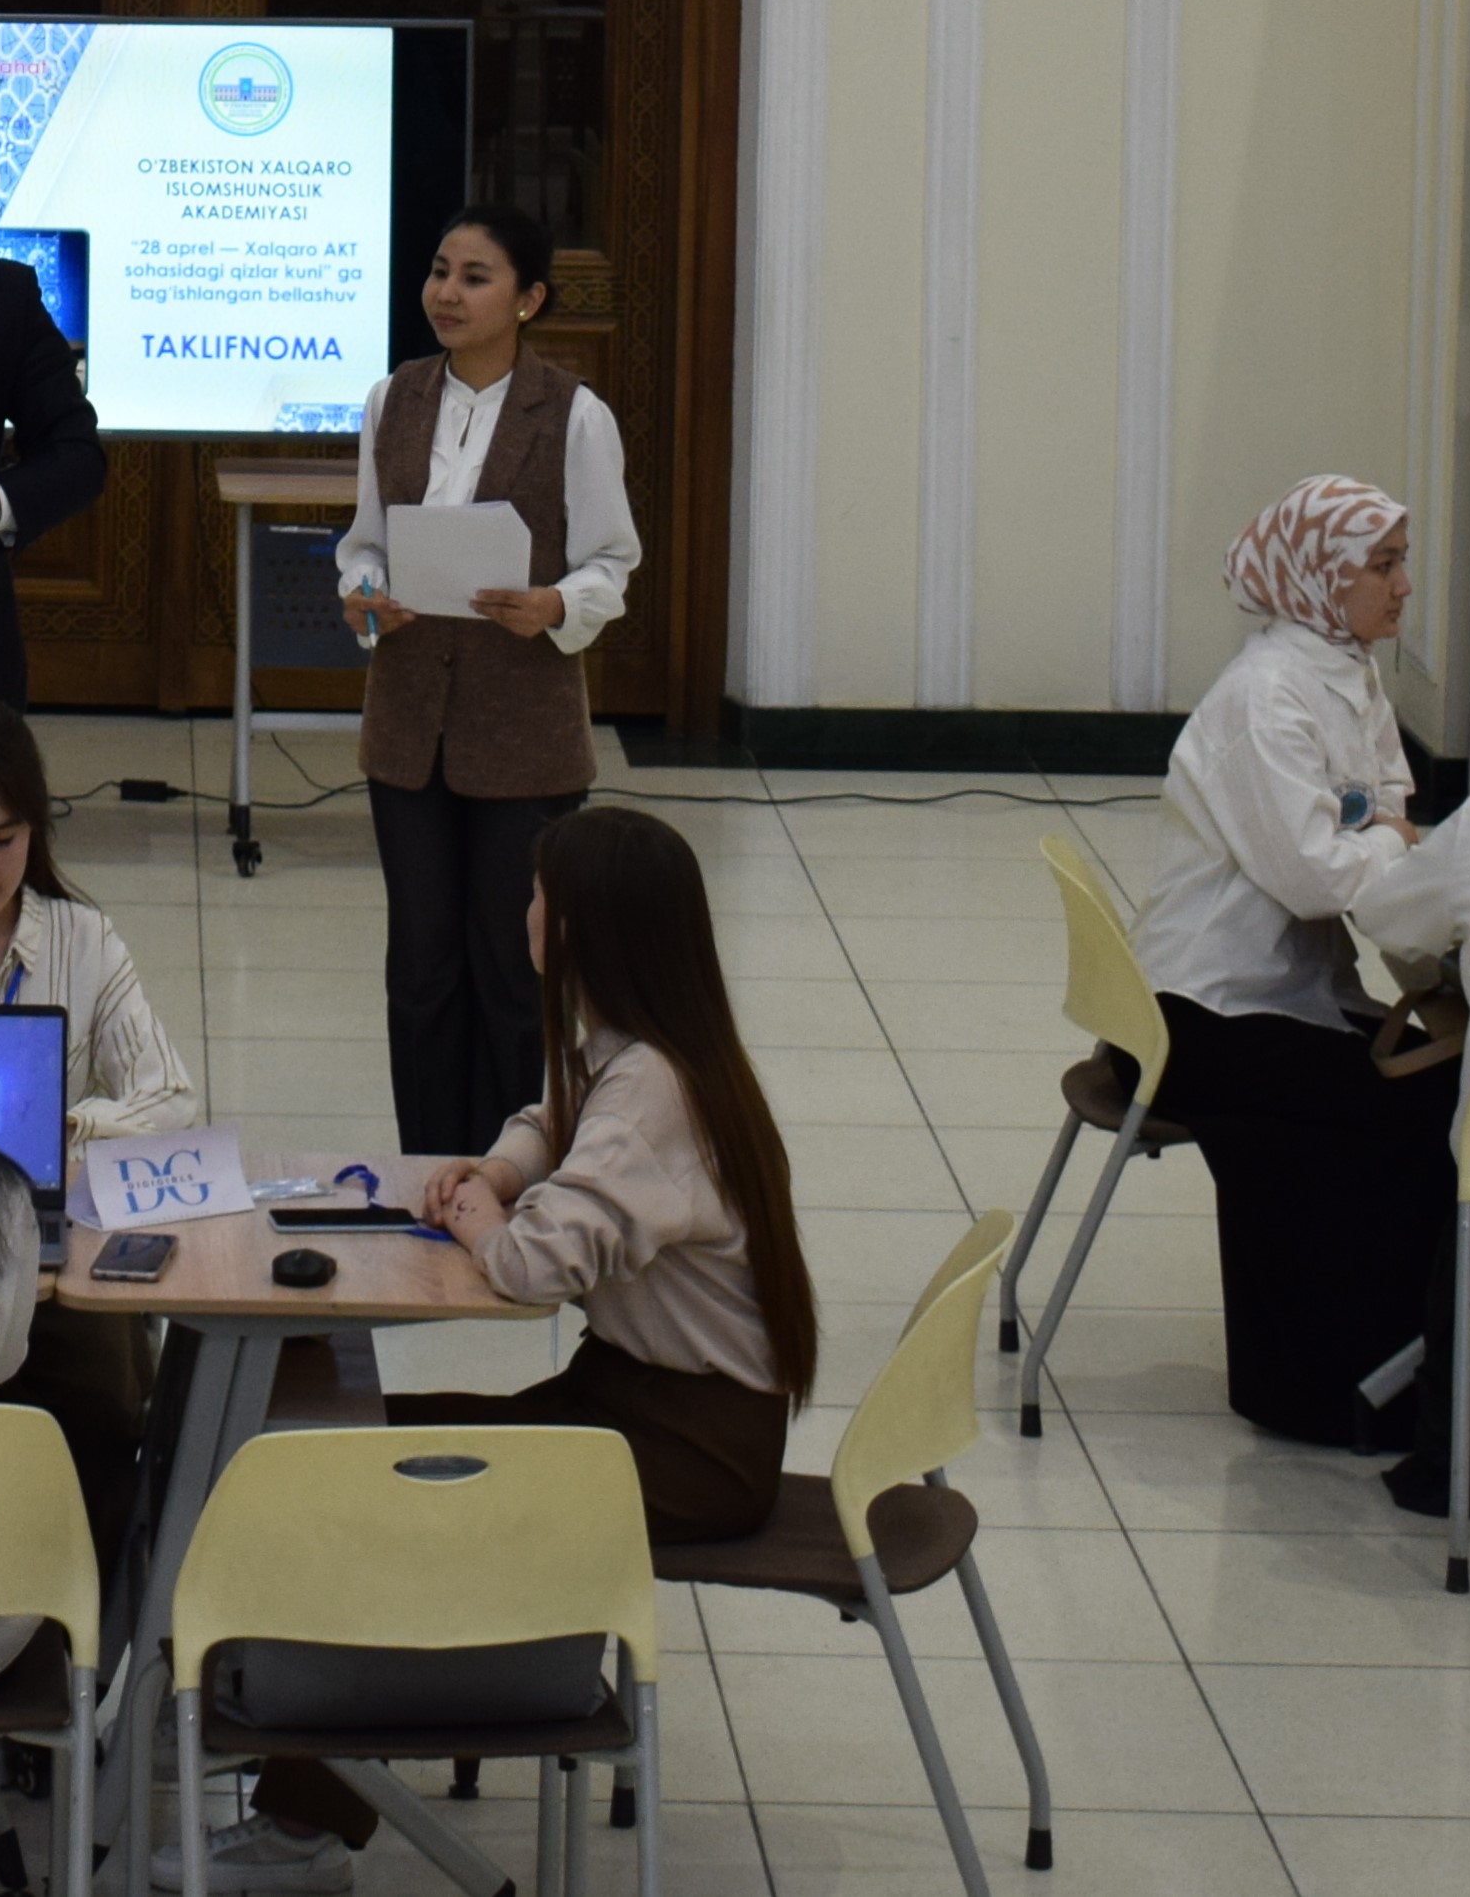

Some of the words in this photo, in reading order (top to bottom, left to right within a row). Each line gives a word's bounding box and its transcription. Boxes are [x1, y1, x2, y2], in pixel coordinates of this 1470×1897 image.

[261, 160, 352, 176] XALQARO
[166, 182, 322, 198] ISLOMSHUNOSLIK
[181, 205, 308, 220] AKADEMIYASI
[167, 241, 214, 258] aprel
[245, 242, 317, 259] Xalqaro
[324, 243, 357, 257] AKT
[125, 263, 224, 281] sohasidagi
[230, 264, 278, 281] qizlar
[338, 268, 362, 283] ga
[268, 287, 356, 302] bellashuv
[142, 334, 342, 361] TAKLIFNOMA
[113, 1148, 213, 1215] DG
[127, 1173, 194, 1190] DIGIGIRLS
